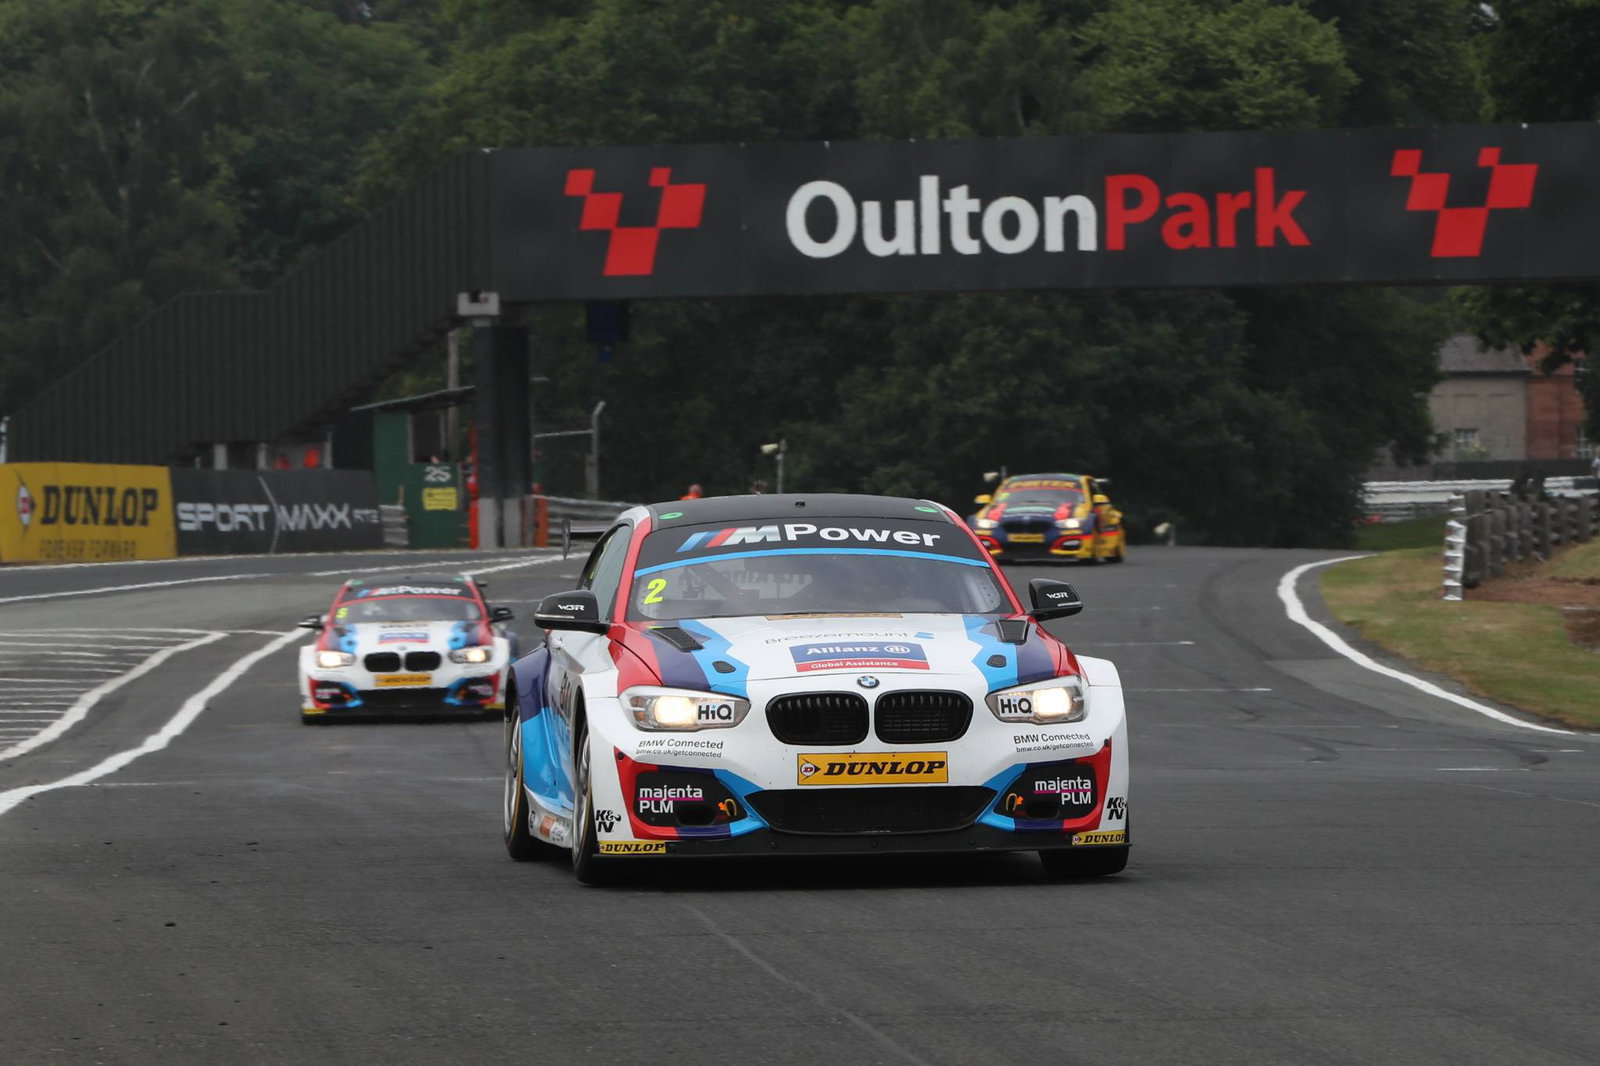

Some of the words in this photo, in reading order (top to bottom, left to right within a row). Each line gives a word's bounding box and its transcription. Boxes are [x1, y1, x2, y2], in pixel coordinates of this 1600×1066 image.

[424, 465, 452, 482] 25
[40, 485, 159, 527] DUNLOP
[176, 502, 270, 532] SPORT
[277, 503, 350, 531] MAXX
[644, 578, 667, 605] 2
[765, 632, 908, 645] Breezemount
[806, 645, 880, 656] Allianz
[811, 661, 844, 669] Global
[845, 660, 899, 668] Assistance
[698, 704, 732, 721] HiQ
[1000, 697, 1033, 715] HiQ
[638, 739, 666, 748] BMW
[667, 738, 724, 749] Connected
[1013, 733, 1039, 745] BMW
[1041, 732, 1091, 743] Connected
[823, 760, 945, 776] DUNLOP
[1035, 776, 1092, 793] majenta
[638, 784, 703, 802] majenta
[1061, 791, 1092, 806] PLM
[639, 800, 674, 814] PLM
[605, 843, 666, 853] DUNLOP
